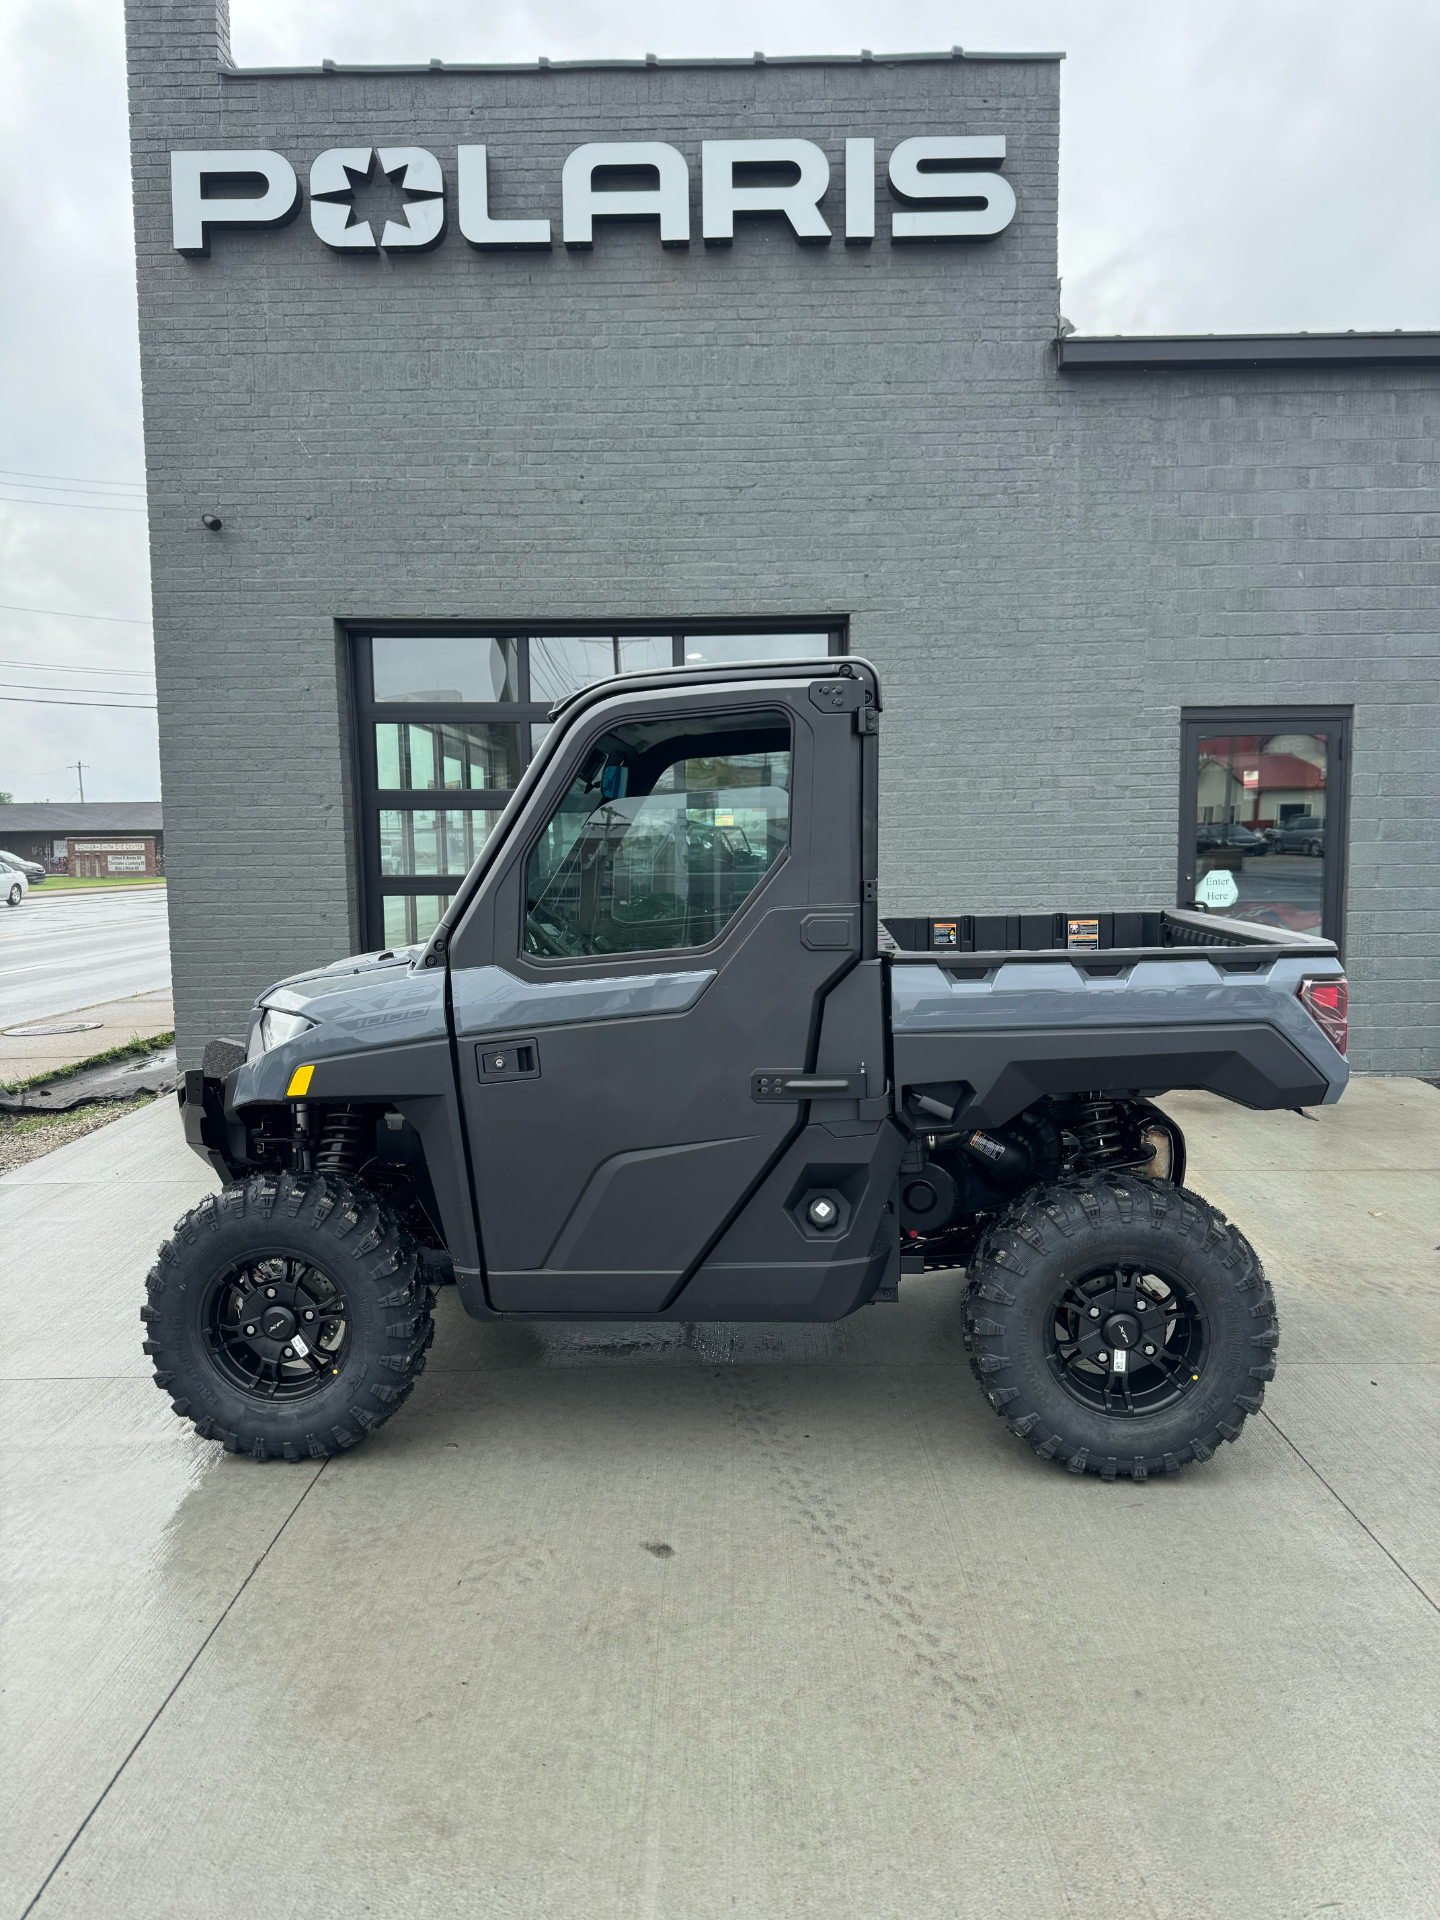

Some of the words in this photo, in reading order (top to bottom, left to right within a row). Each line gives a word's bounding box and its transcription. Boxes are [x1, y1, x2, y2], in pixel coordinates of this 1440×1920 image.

[170, 134, 1018, 253] POLARIS
[1205, 877, 1230, 886] Enter
[1207, 891, 1229, 900] Here
[332, 984, 441, 1020] XP
[1016, 985, 1244, 1012] RANGER
[356, 1005, 432, 1029] 1000
[193, 1380, 219, 1407] PRO
